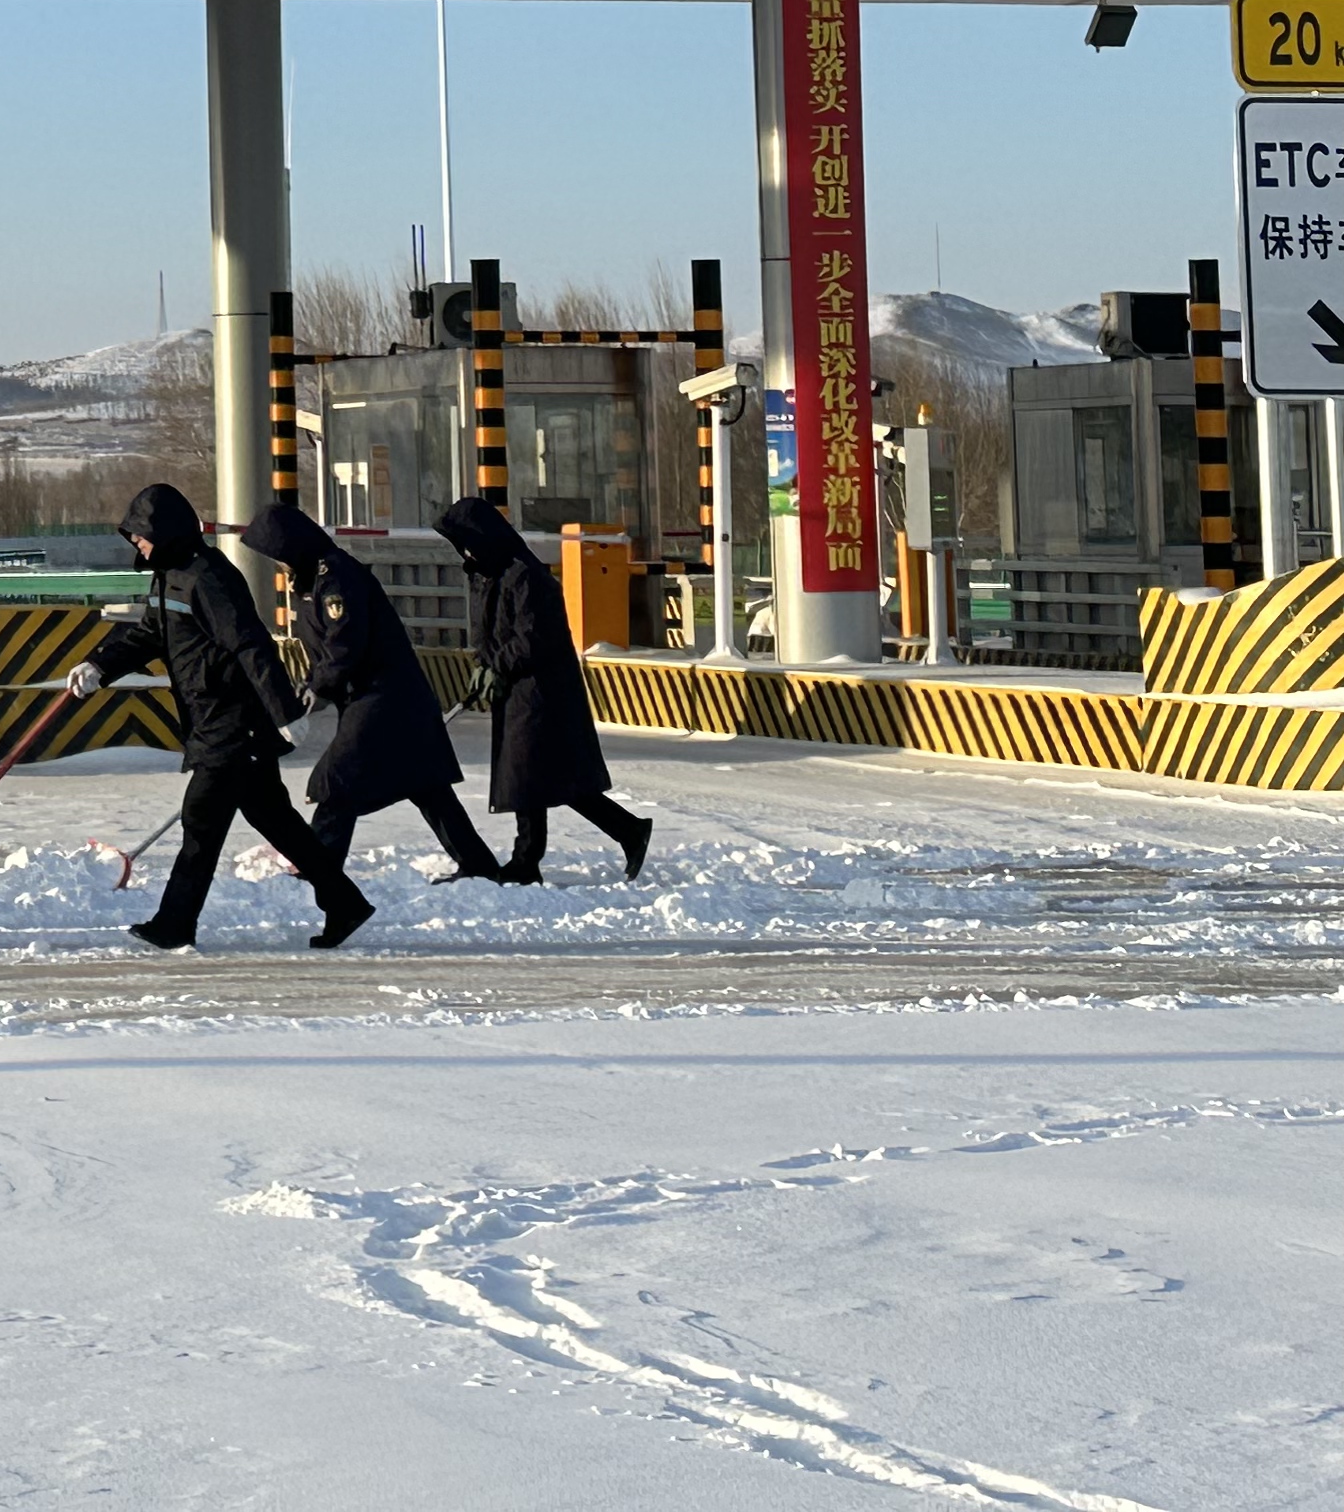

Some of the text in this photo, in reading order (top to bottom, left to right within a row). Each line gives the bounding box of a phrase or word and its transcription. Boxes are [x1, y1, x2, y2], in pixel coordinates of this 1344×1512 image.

[1268, 11, 1322, 66] 20
[1259, 213, 1344, 261] 保持
[809, 123, 864, 571] 开创进一步全面深化改革新局面
